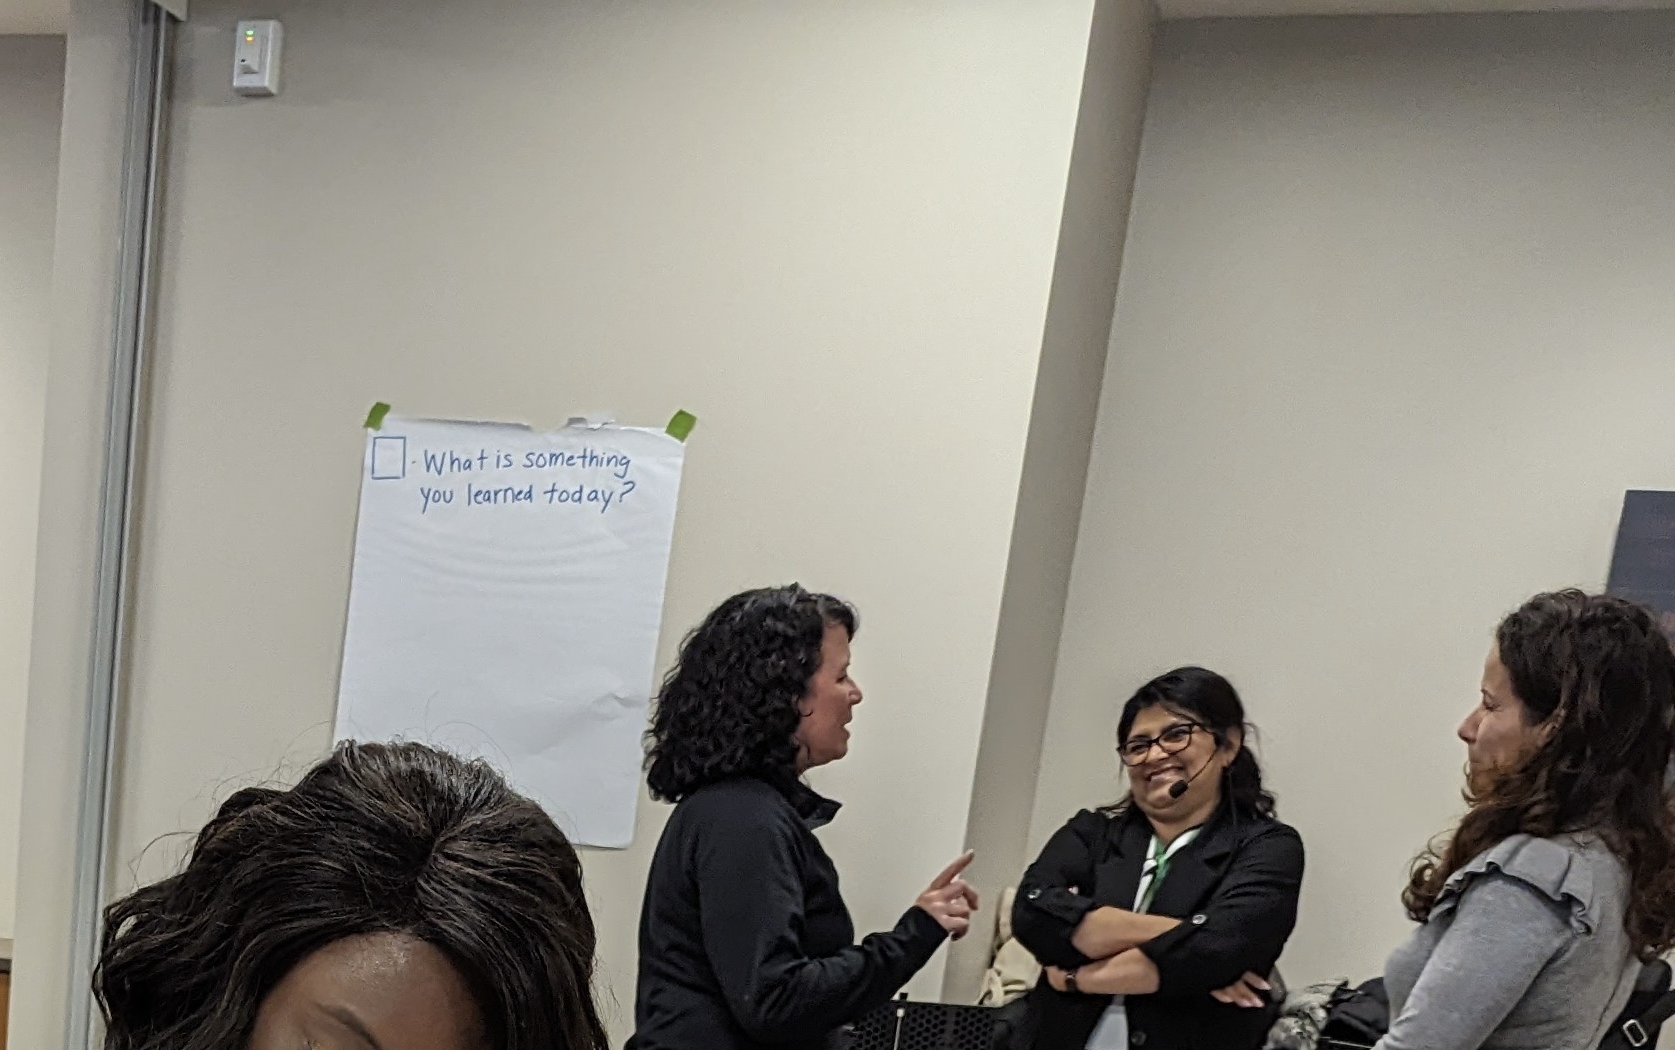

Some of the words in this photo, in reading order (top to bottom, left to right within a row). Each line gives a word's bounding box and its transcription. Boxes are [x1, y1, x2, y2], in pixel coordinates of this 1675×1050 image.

[425, 449, 488, 476] What
[496, 450, 513, 469] is
[522, 448, 631, 478] something
[420, 485, 454, 515] you
[467, 483, 533, 507] learned
[543, 480, 636, 514] today?
